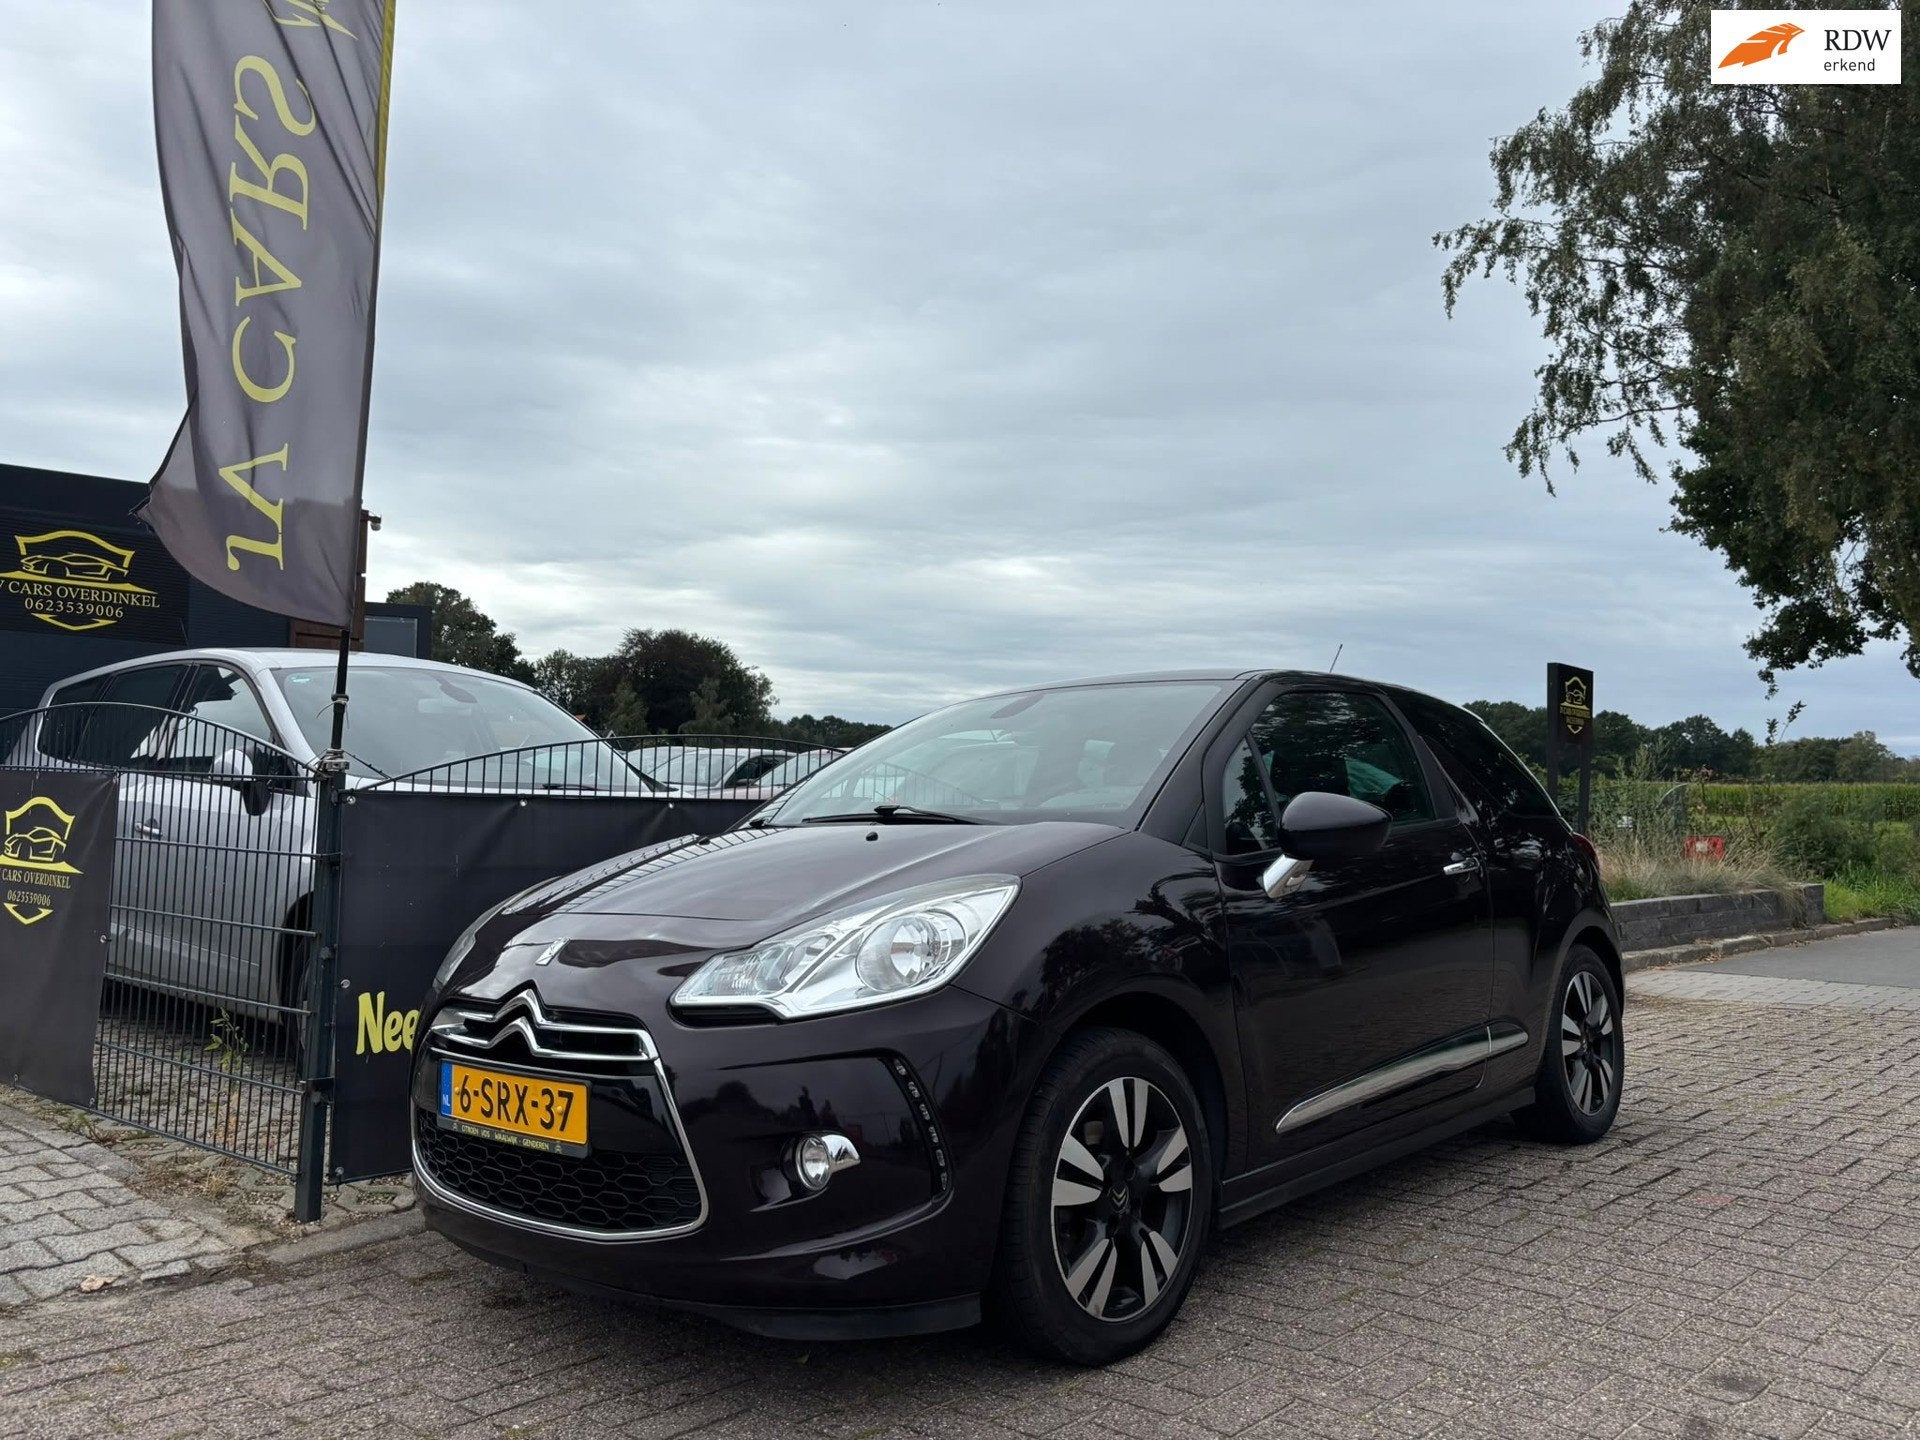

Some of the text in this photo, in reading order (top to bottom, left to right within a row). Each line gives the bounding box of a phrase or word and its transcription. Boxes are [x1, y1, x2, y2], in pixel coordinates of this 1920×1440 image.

[8, 580, 160, 608] CARS OVERDINKEL
[25, 597, 124, 618] 0623539006
[2, 868, 71, 889] CARS OVERDINKEL
[442, 1094, 450, 1107] NL
[460, 1074, 574, 1132] 6-SRX-37
